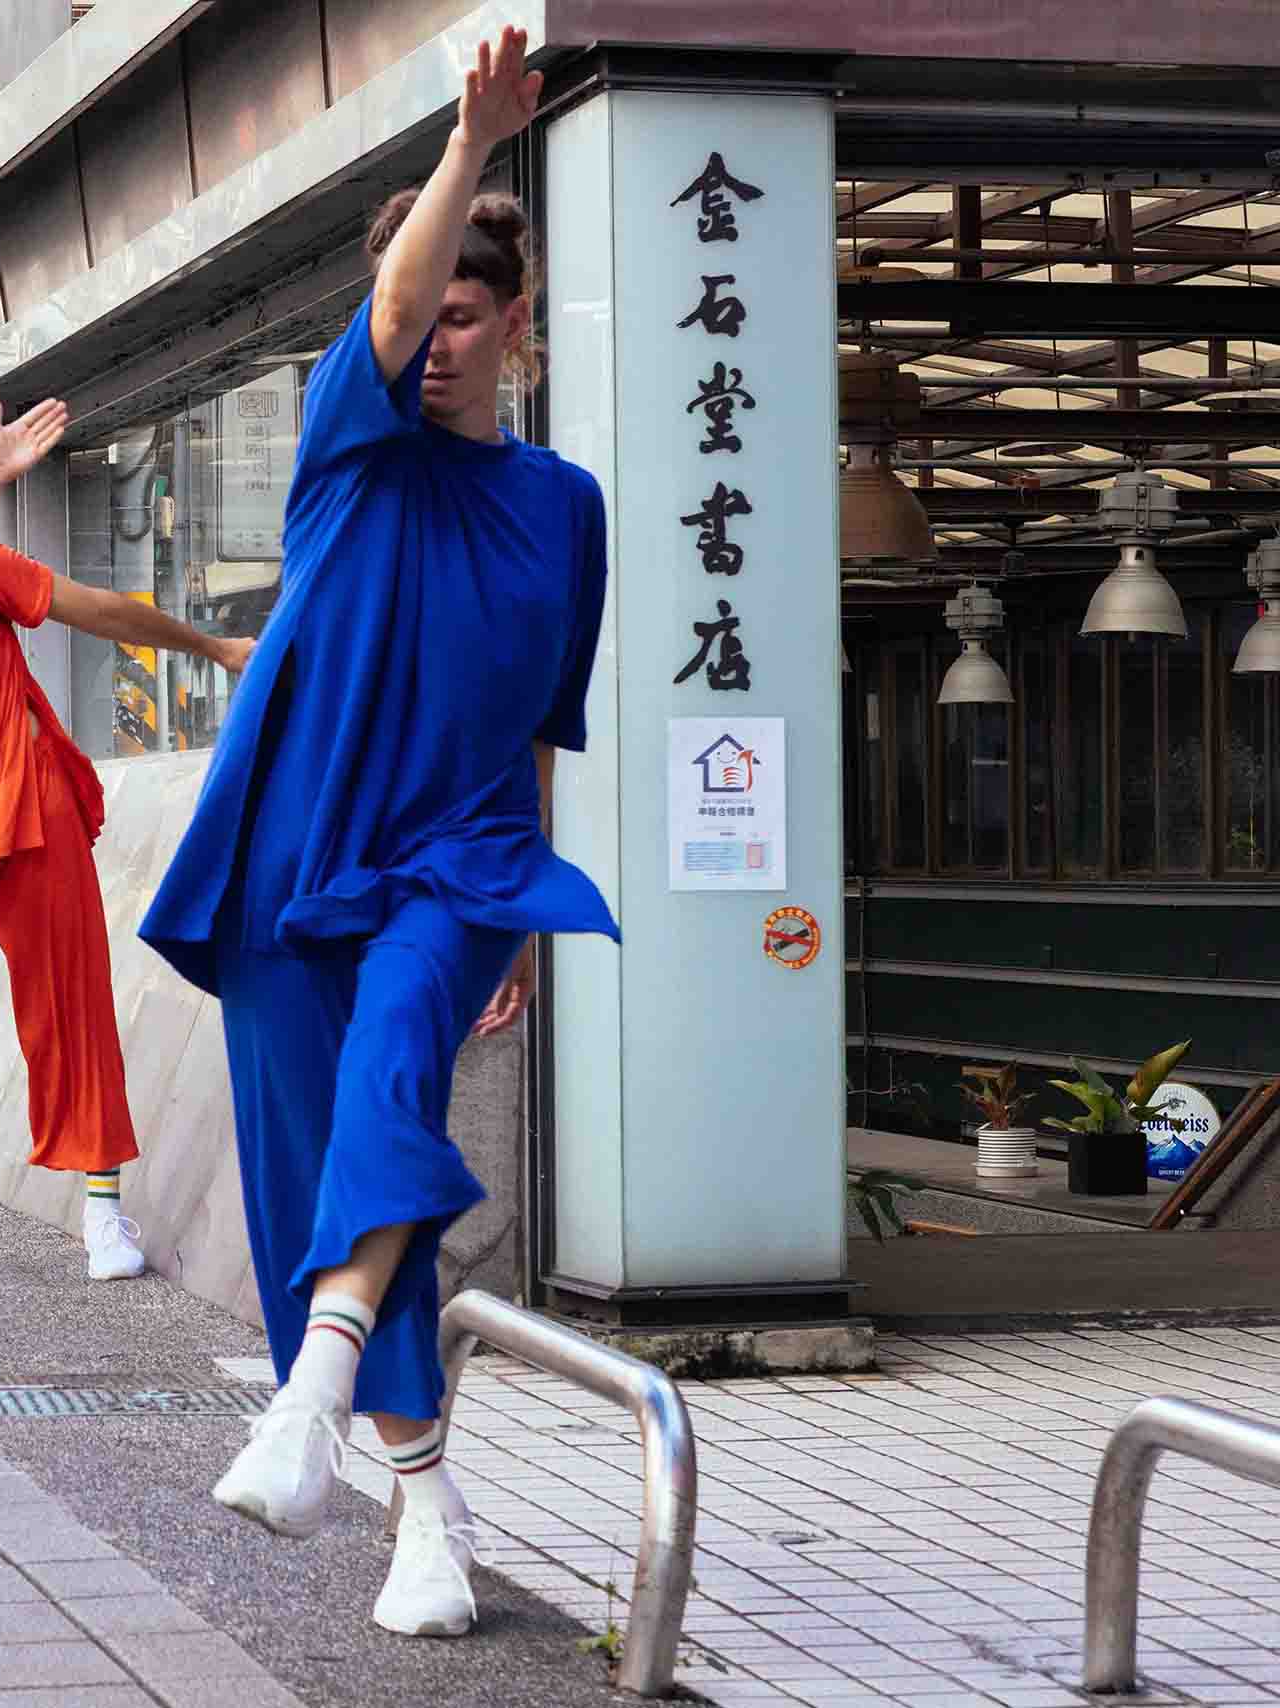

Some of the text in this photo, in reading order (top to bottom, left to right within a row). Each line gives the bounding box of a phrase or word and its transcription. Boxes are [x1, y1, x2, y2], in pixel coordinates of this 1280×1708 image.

[670, 151, 765, 692] 金石堂書店
